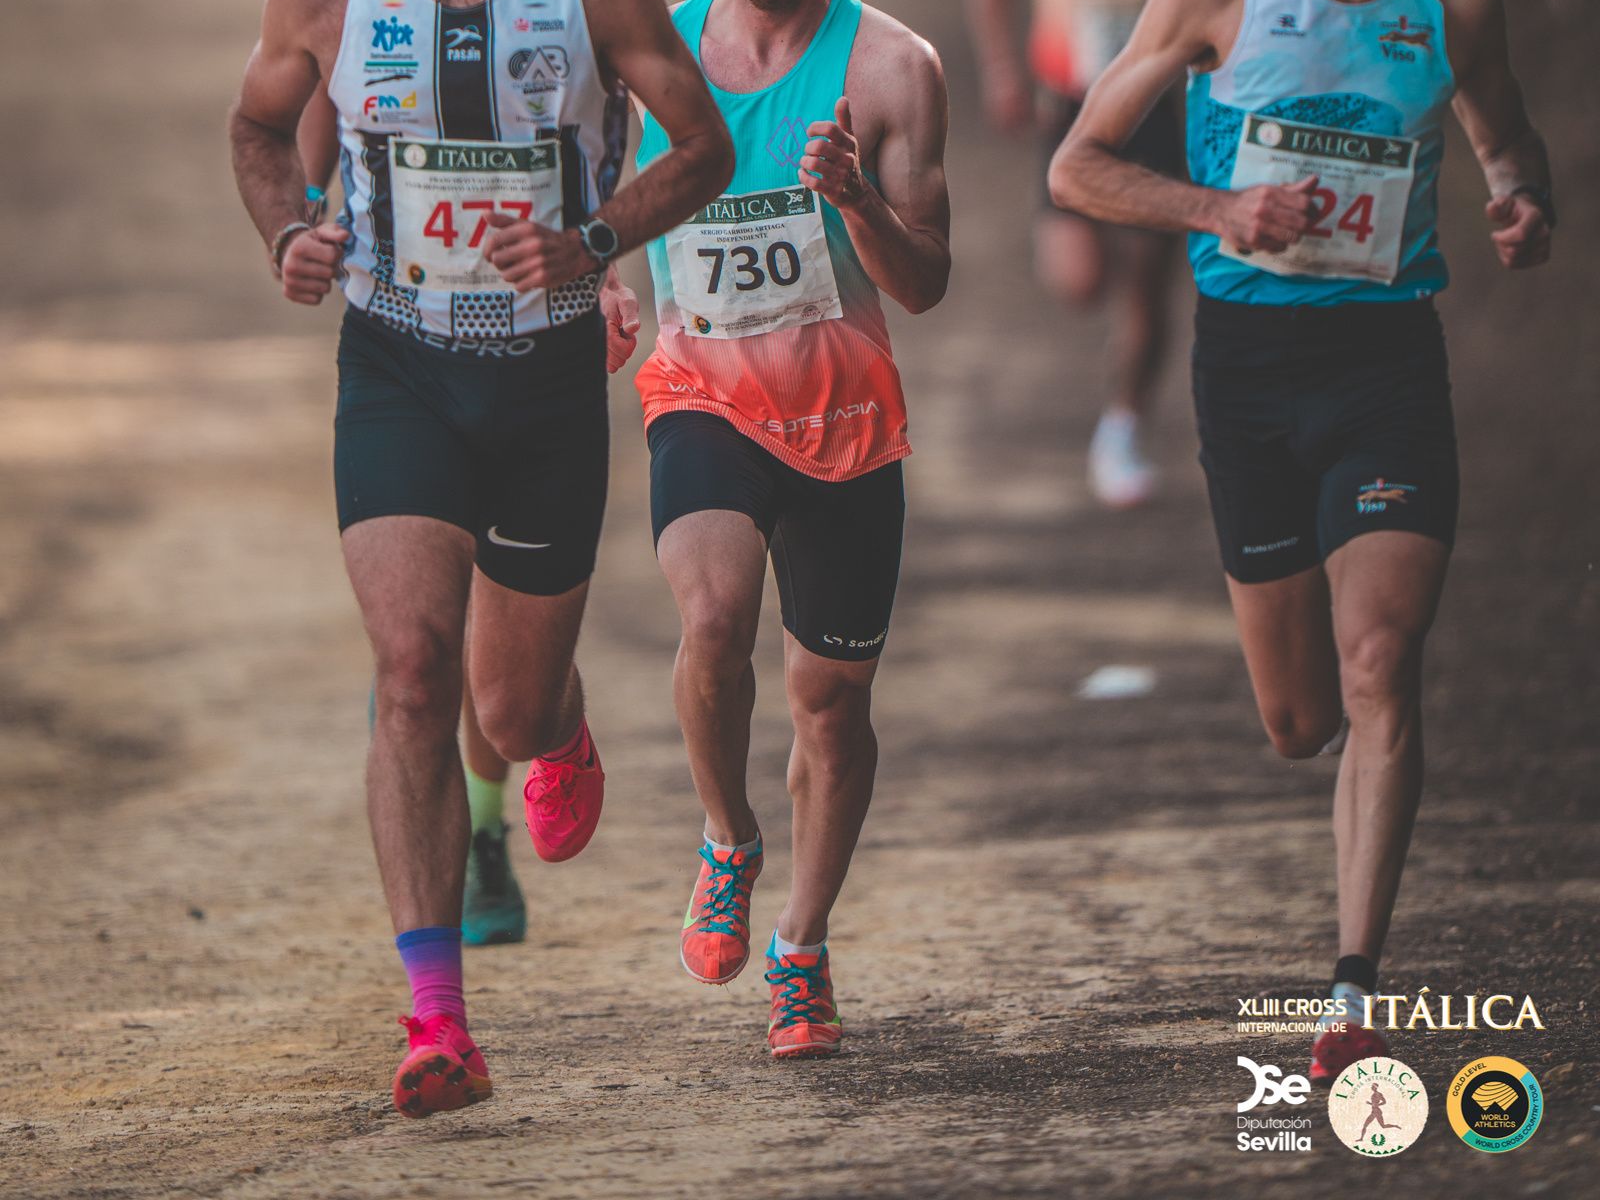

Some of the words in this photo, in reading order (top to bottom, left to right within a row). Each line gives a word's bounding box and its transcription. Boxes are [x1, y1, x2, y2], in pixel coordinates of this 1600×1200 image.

[1381, 42, 1416, 64] Viso
[363, 90, 417, 117] fmd
[437, 147, 518, 169] ITÁLICA
[705, 198, 777, 219] ITÁLICA
[1309, 186, 1375, 244] 24
[717, 232, 769, 243] INDEPENDIENTE
[723, 227, 753, 236] GARRIDO
[754, 223, 786, 233] ARTIAGA
[697, 240, 802, 294] 730
[450, 336, 537, 358] PRO
